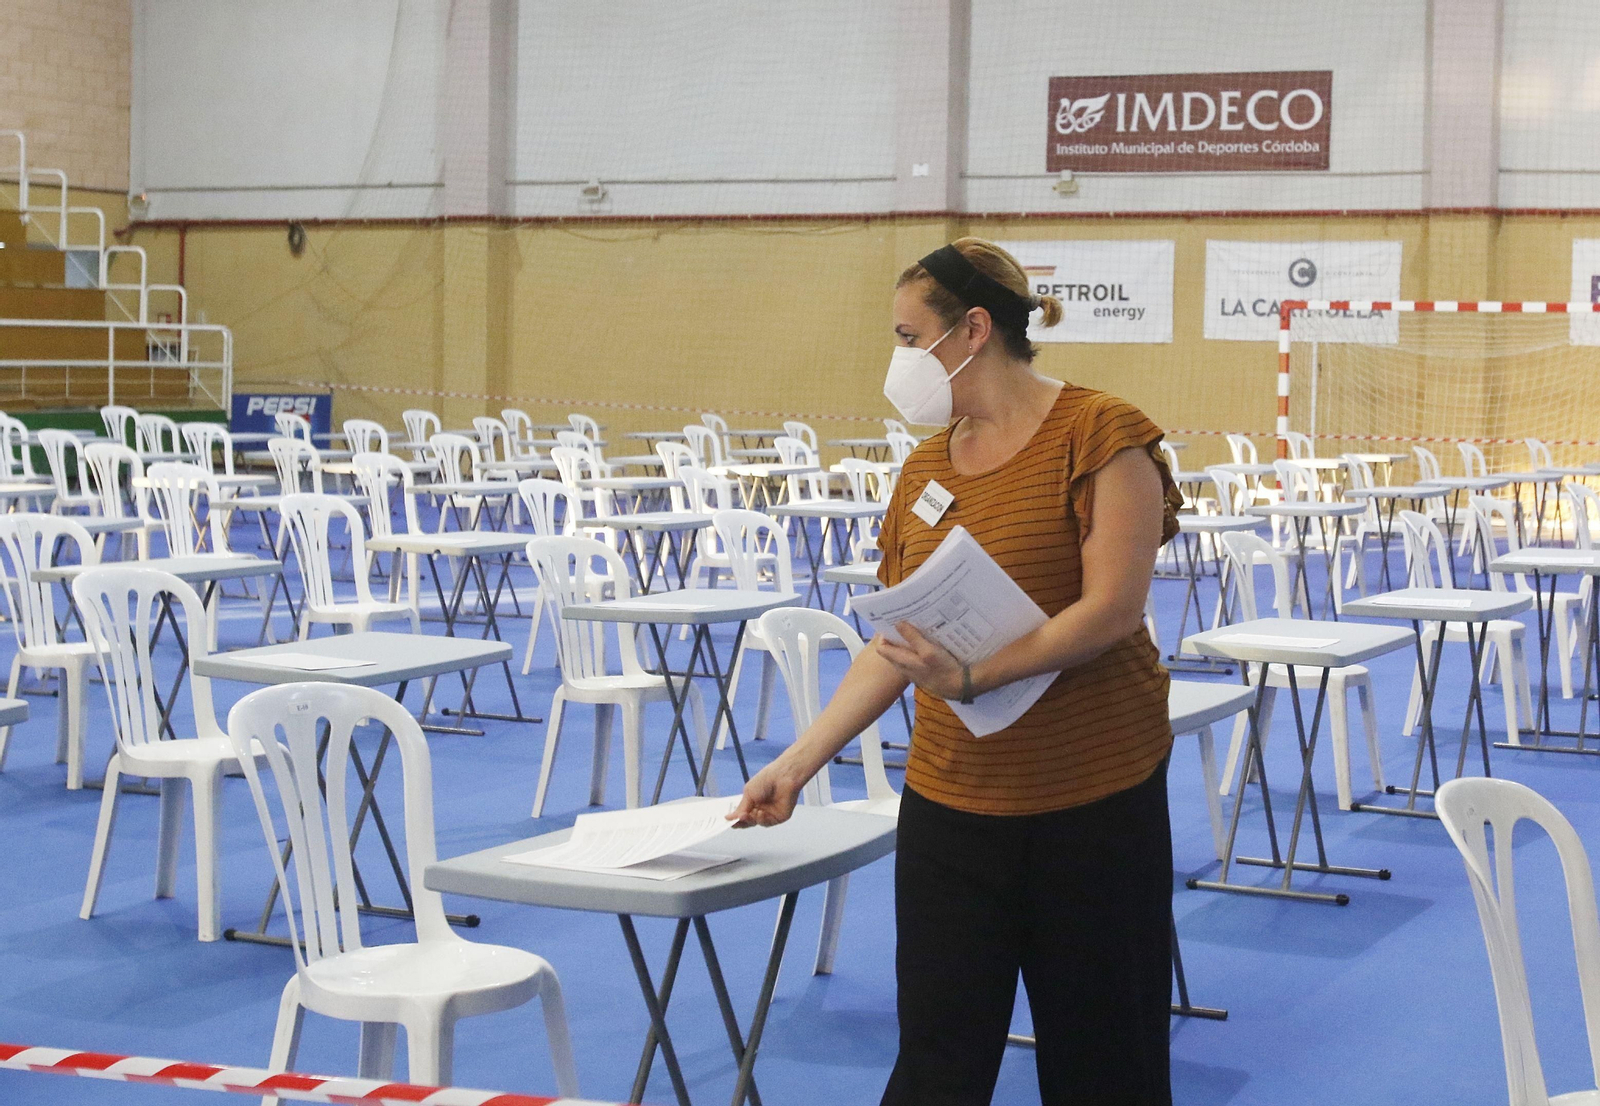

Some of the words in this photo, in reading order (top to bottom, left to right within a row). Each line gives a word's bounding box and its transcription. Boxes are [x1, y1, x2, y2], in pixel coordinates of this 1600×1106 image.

[1116, 89, 1323, 132] IMDECO
[1056, 143, 1108, 155] Instituto
[1111, 142, 1174, 157] Municipal
[1177, 142, 1194, 154] de
[1199, 141, 1259, 156] Deportes
[1262, 139, 1320, 153] Córdoba
[1037, 284, 1130, 301] PETROIL
[1093, 306, 1146, 321] energy
[1220, 298, 1247, 317] LA
[246, 396, 317, 416] PEPSI
